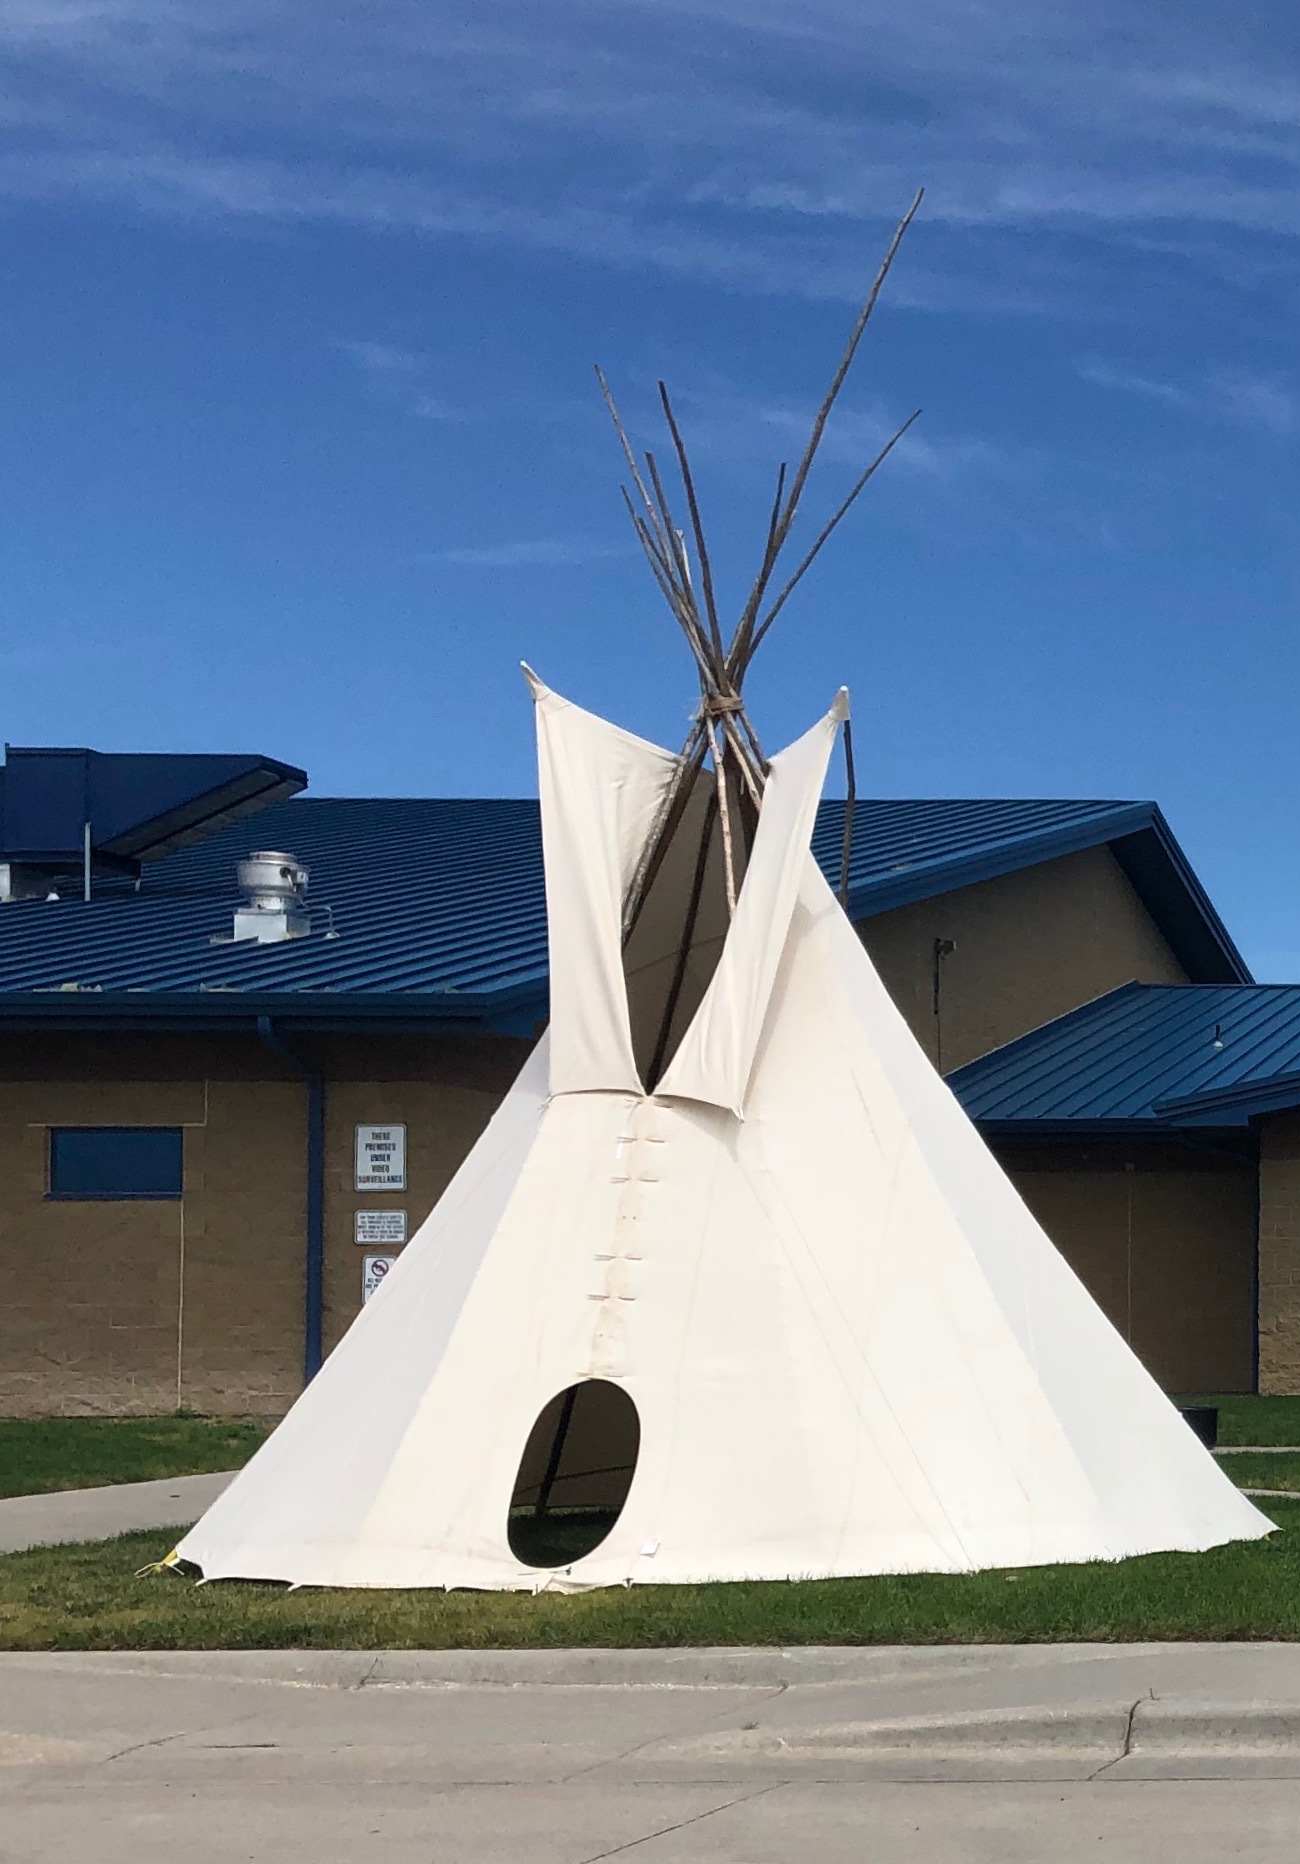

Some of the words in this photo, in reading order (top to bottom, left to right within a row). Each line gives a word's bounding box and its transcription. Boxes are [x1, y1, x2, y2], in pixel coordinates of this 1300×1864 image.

[365, 1143, 396, 1151] PREMISES
[370, 1154, 391, 1162] UNDER
[371, 1165, 390, 1173] VIDEO
[358, 1175, 402, 1183] SURVEILLANCE
